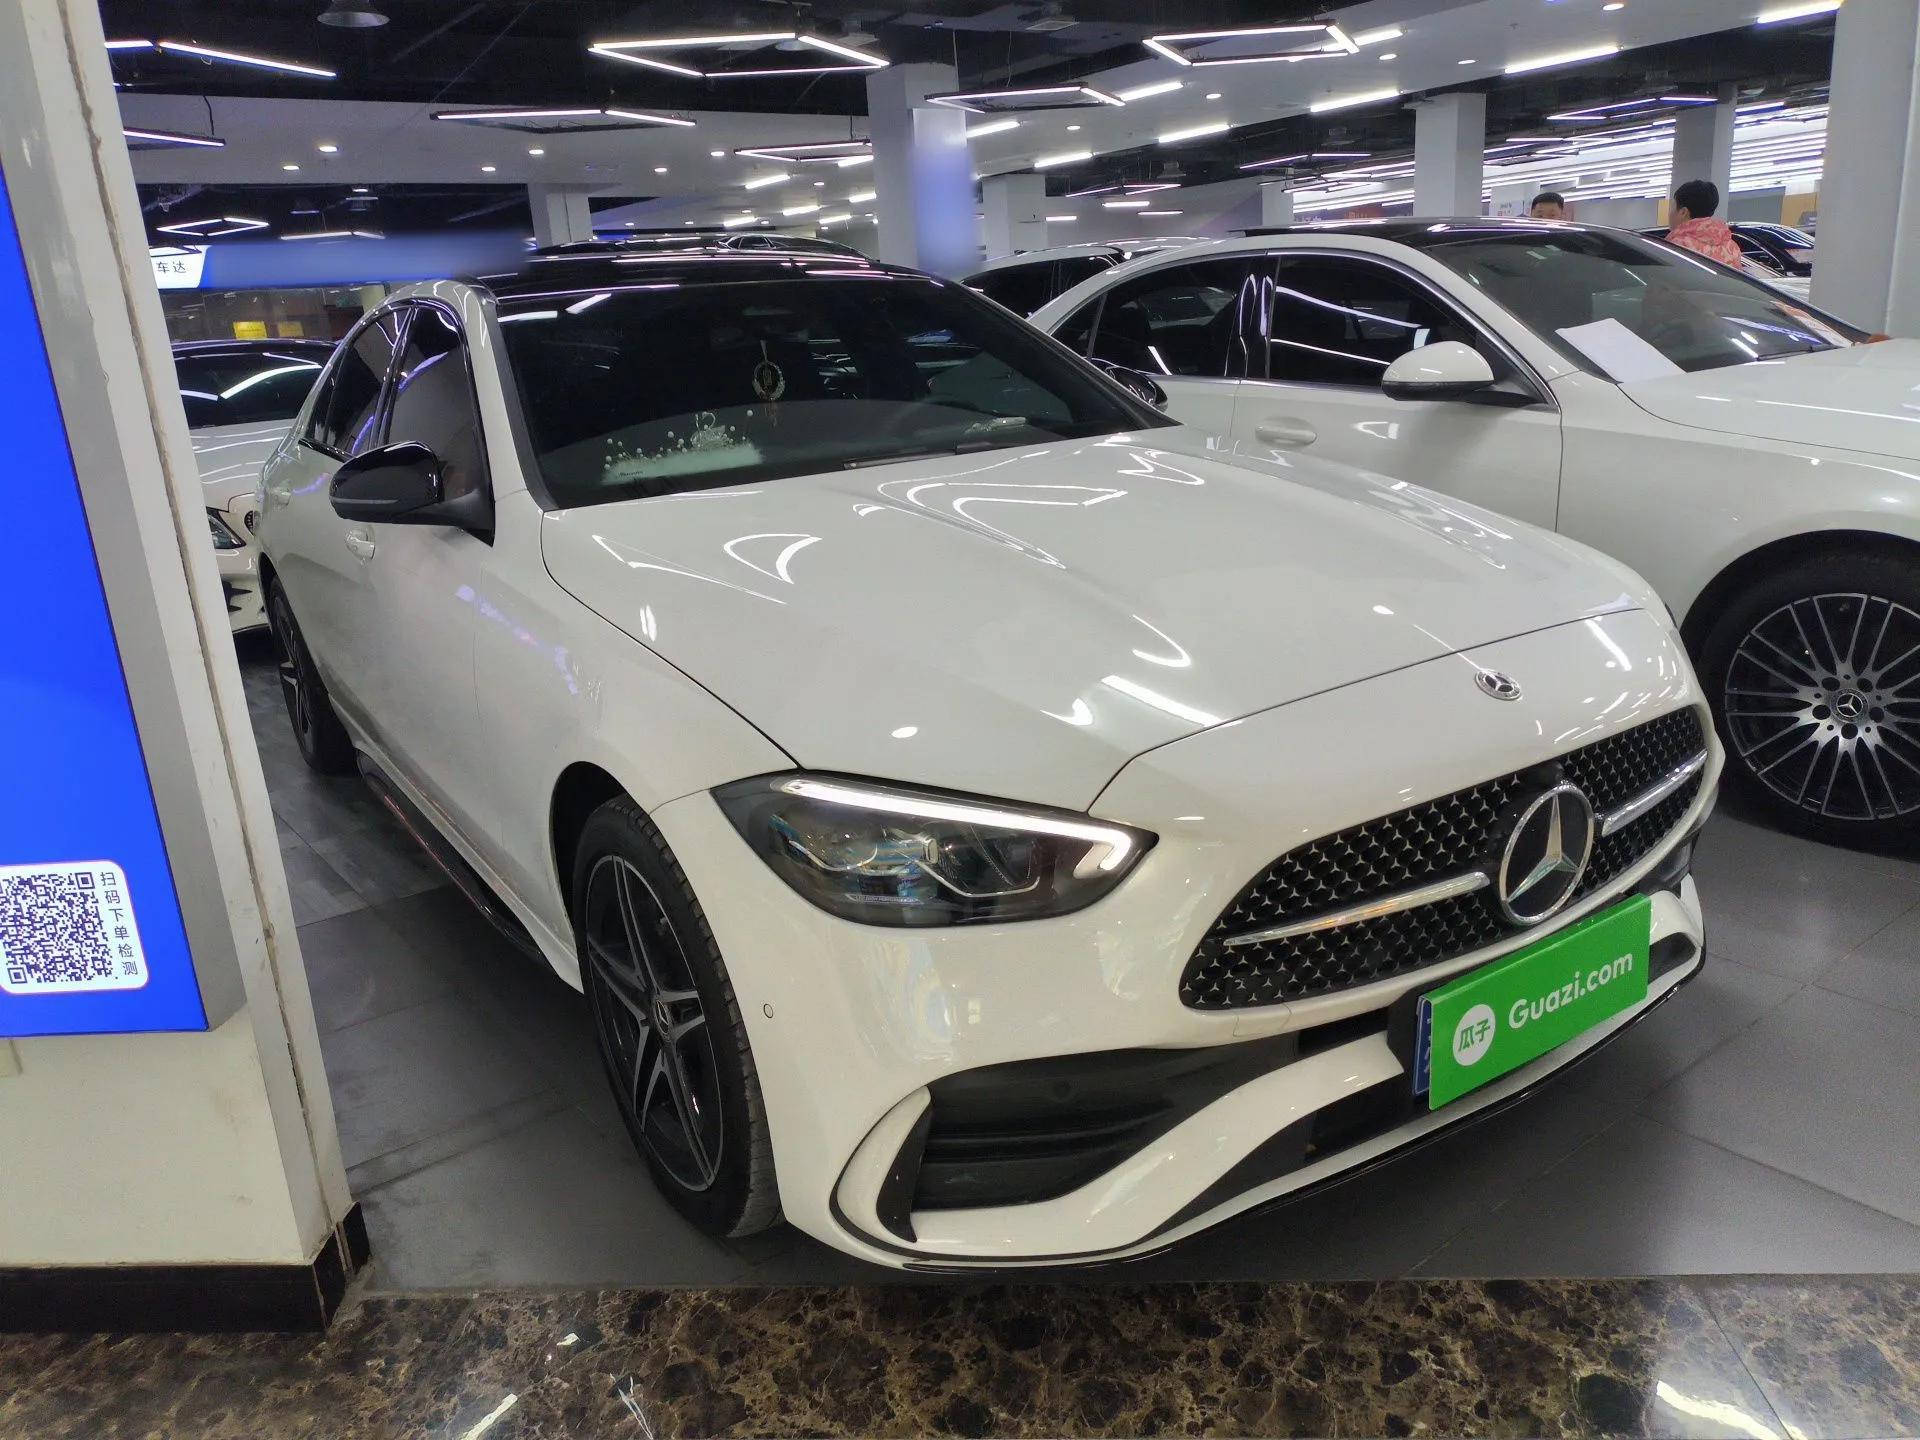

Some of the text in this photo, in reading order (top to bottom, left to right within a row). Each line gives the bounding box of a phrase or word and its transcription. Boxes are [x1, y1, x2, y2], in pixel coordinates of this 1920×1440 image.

[156, 260, 187, 274] 车达
[100, 871, 139, 976] 扫码下单检测
[1508, 953, 1633, 1029] Guazi.com
[1458, 1018, 1491, 1053] 瓜子
